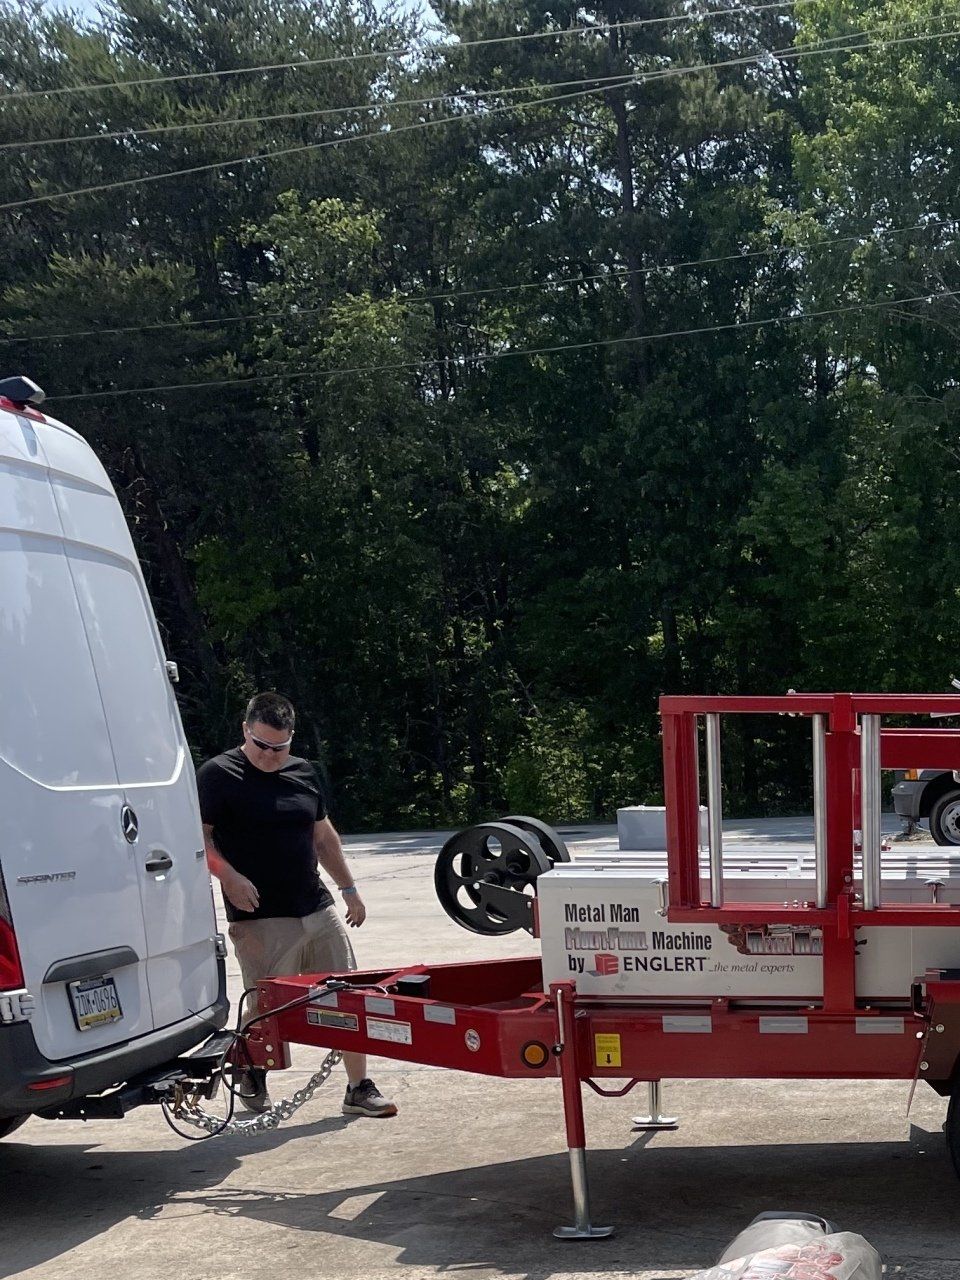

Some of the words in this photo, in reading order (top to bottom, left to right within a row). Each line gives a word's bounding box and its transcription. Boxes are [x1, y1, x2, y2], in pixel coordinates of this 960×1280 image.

[564, 903, 605, 923] Metal
[609, 903, 640, 923] Man
[652, 931, 712, 951] Machine
[568, 954, 585, 974] by
[623, 956, 707, 972] ENGLERT
[731, 962, 758, 973] metal
[760, 962, 795, 975] experts
